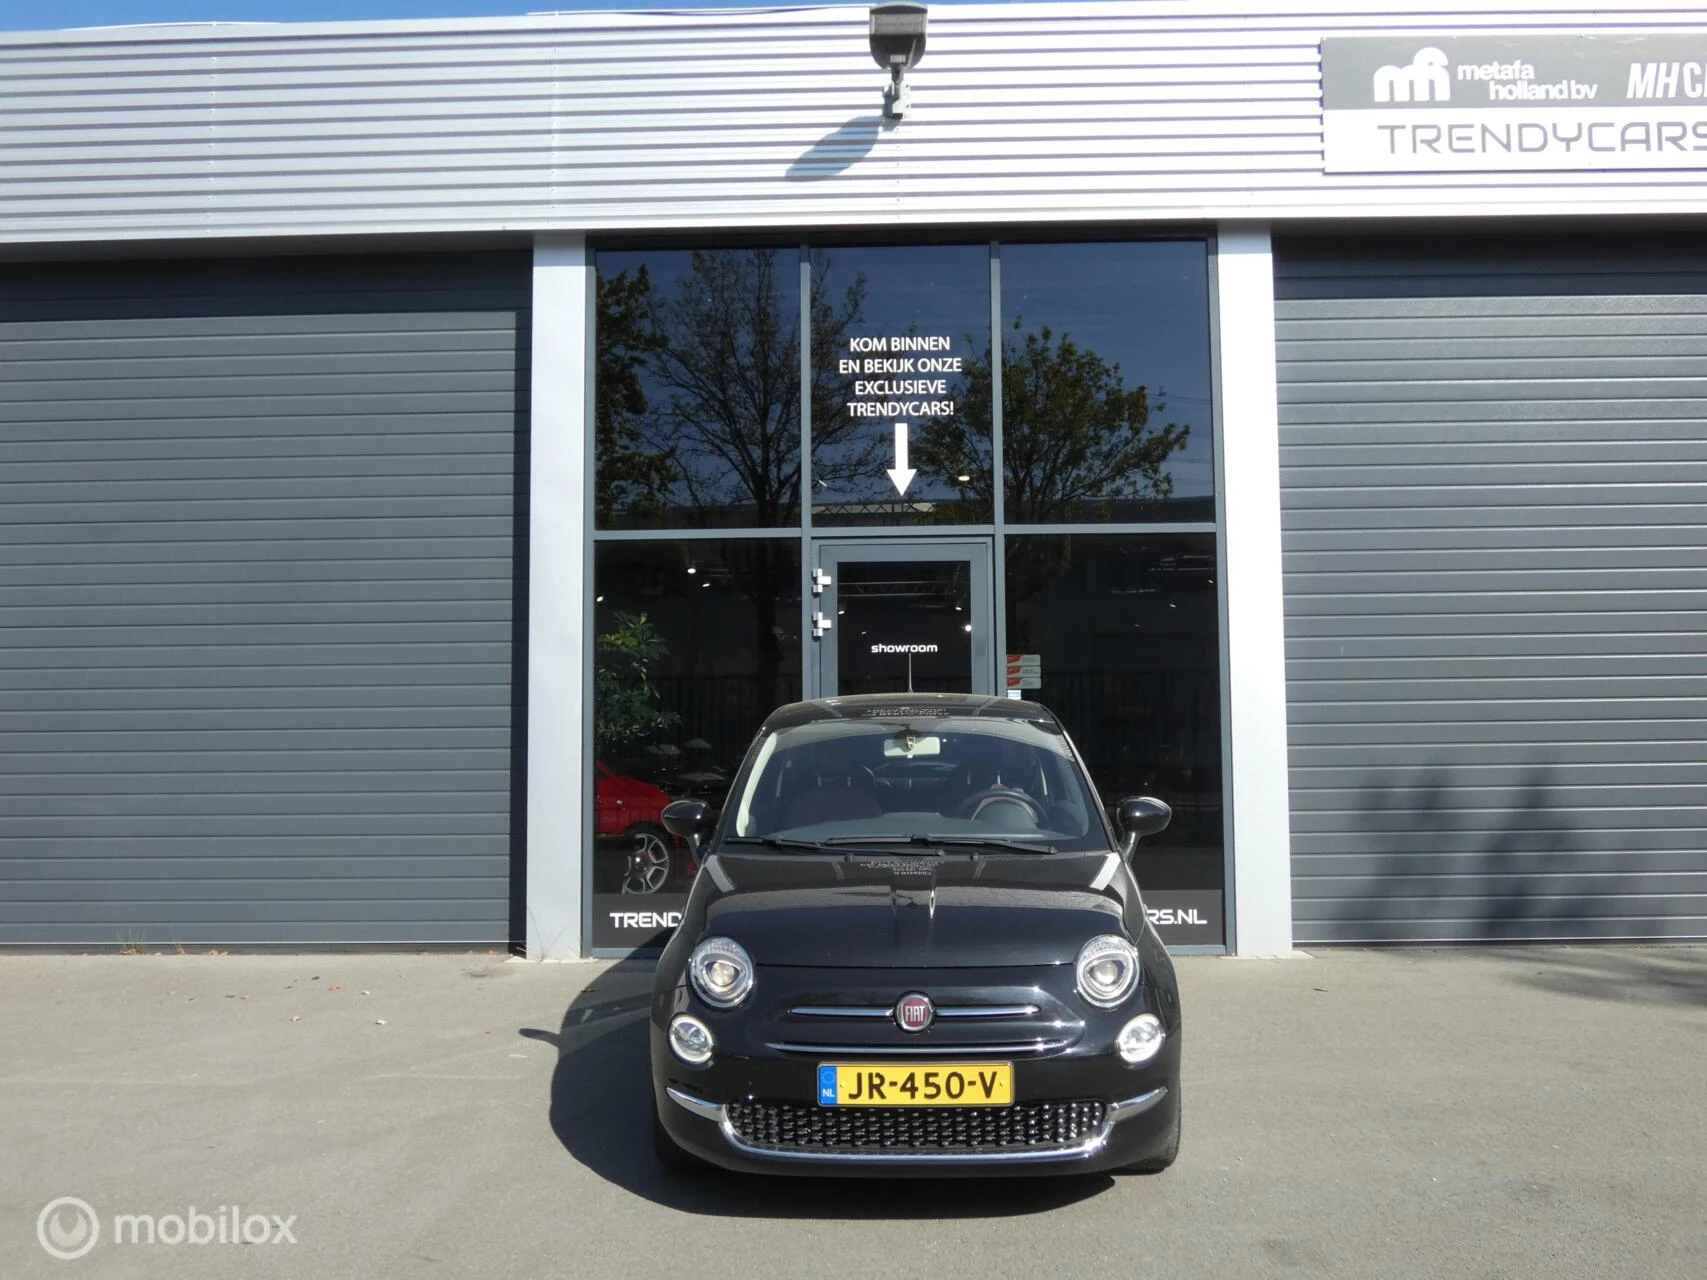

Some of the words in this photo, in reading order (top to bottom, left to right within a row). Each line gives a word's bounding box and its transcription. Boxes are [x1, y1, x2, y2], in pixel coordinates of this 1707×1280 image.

[1457, 60, 1535, 80] metafa
[1626, 61, 1707, 99] MHC
[850, 337, 887, 352] KOM
[891, 336, 951, 351] BINNEN
[840, 359, 860, 373] EN
[864, 358, 914, 373] BEKIJK
[917, 358, 962, 372] ONZE
[855, 380, 947, 395] EXCLUSIEVE
[847, 401, 954, 417] TRENDYCARS!
[871, 643, 938, 653] showroom
[905, 1005, 925, 1022] FIAT
[822, 1089, 835, 1098] NL
[848, 1071, 998, 1100] JR-450-V
